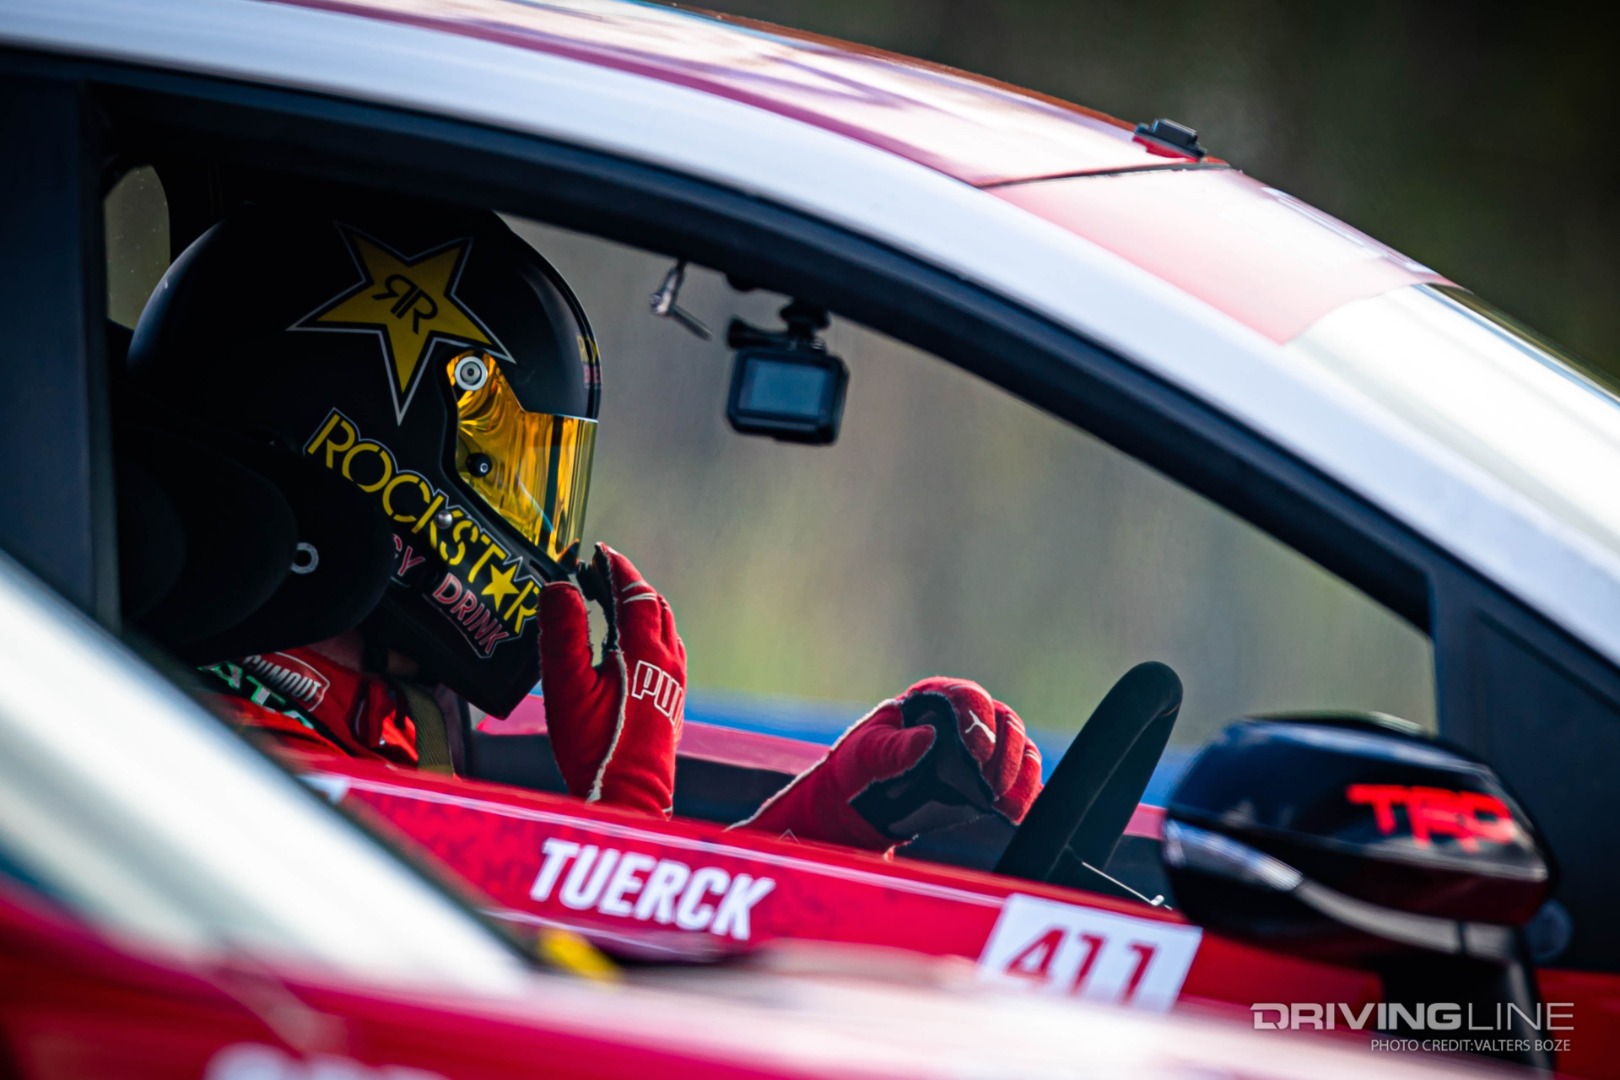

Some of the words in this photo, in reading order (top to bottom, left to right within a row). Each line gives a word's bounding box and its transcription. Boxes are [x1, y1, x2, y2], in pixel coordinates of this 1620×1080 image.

[432, 571, 510, 655] DRINK
[1346, 784, 1515, 854] TRD
[529, 837, 776, 940] TUERCK
[1003, 926, 1158, 1006] 411
